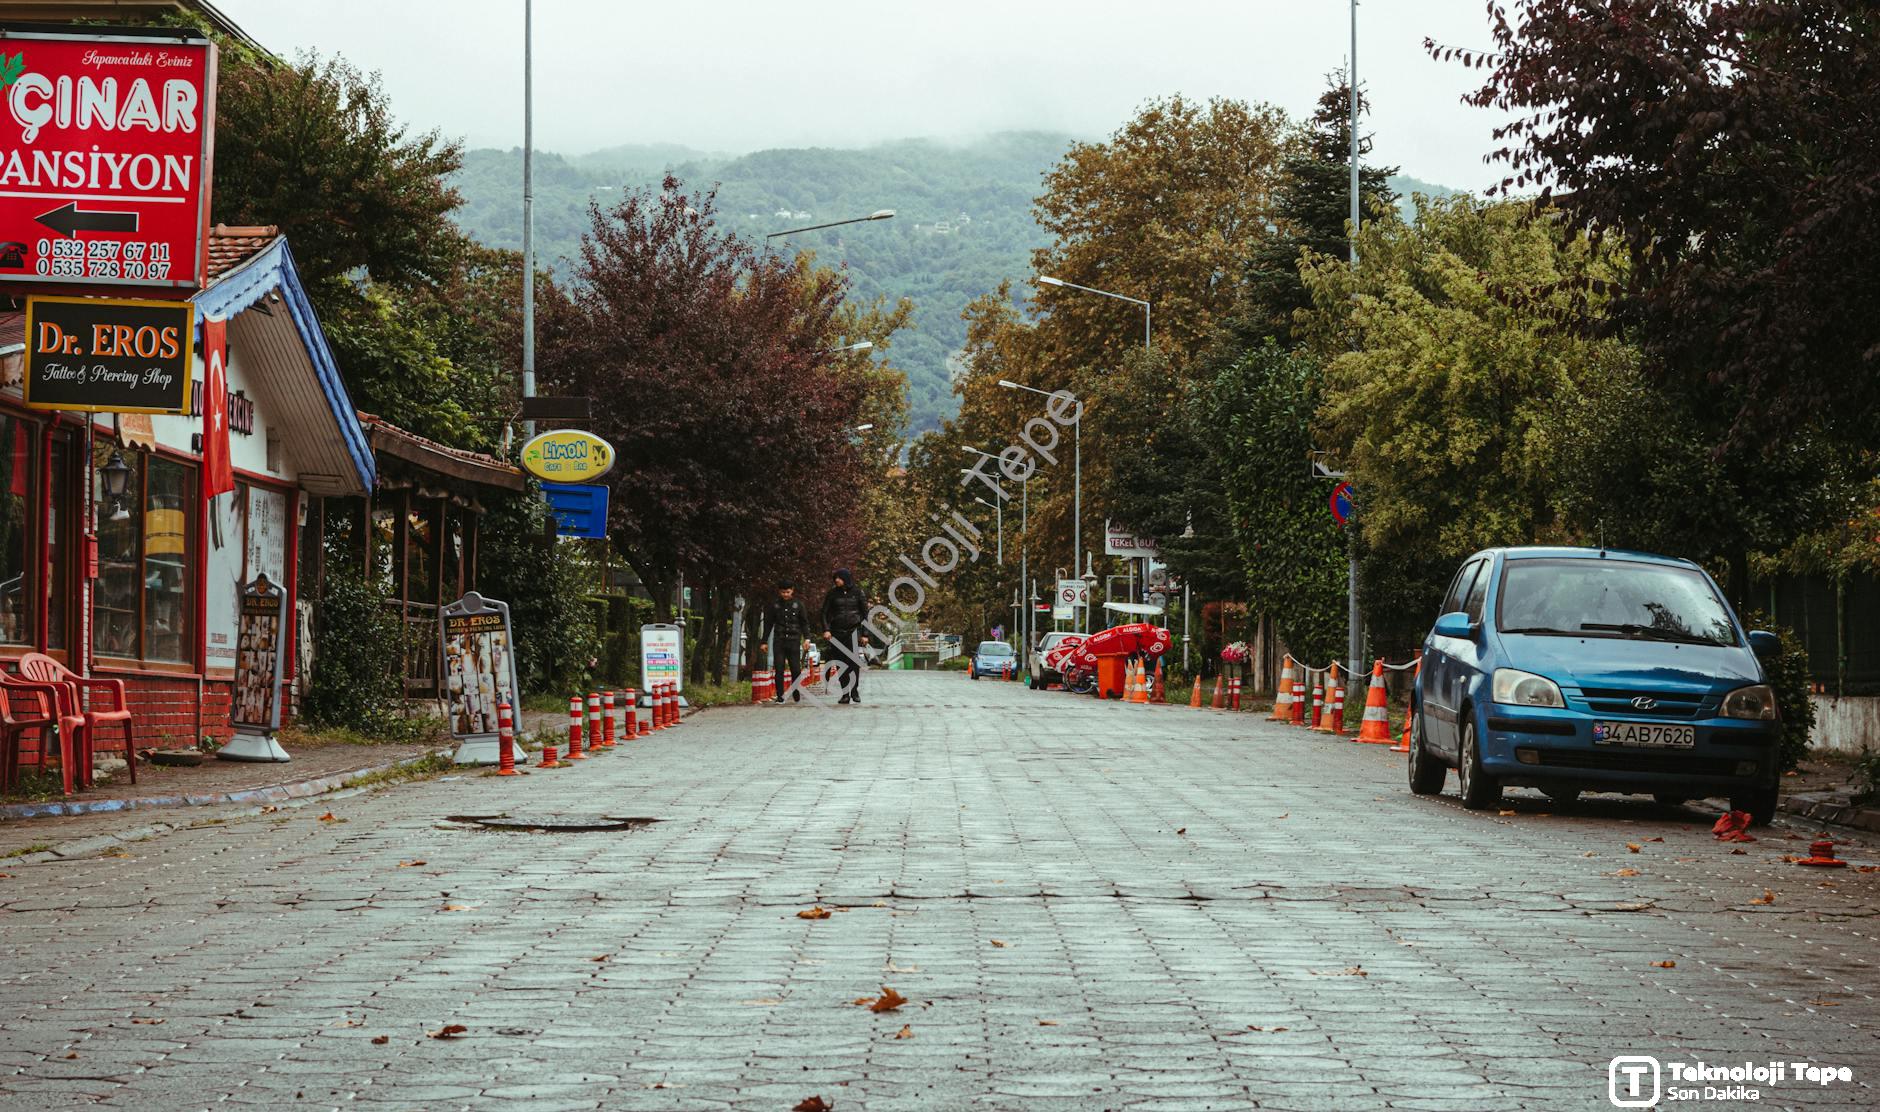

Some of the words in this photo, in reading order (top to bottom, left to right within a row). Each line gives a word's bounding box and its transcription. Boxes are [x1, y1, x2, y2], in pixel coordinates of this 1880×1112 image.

[82, 50, 152, 70] Sapanca'daki
[156, 52, 192, 68] Eviniz
[9, 73, 198, 144] ÇINAR
[38, 239, 50, 256] 0
[52, 240, 84, 258] 532
[88, 242, 120, 258] 257
[123, 243, 145, 260] 67
[150, 244, 170, 261] 11
[37, 259, 49, 276] 0
[52, 260, 84, 276] 535
[87, 261, 119, 278] 728
[123, 262, 145, 279] 70
[148, 263, 170, 280] 97
[38, 321, 82, 355] Dr.
[91, 323, 179, 359] EROS
[89, 364, 139, 390] Piercing
[142, 367, 172, 391] Shop
[1110, 538, 1134, 548] TEKEL
[1602, 725, 1621, 741] 34
